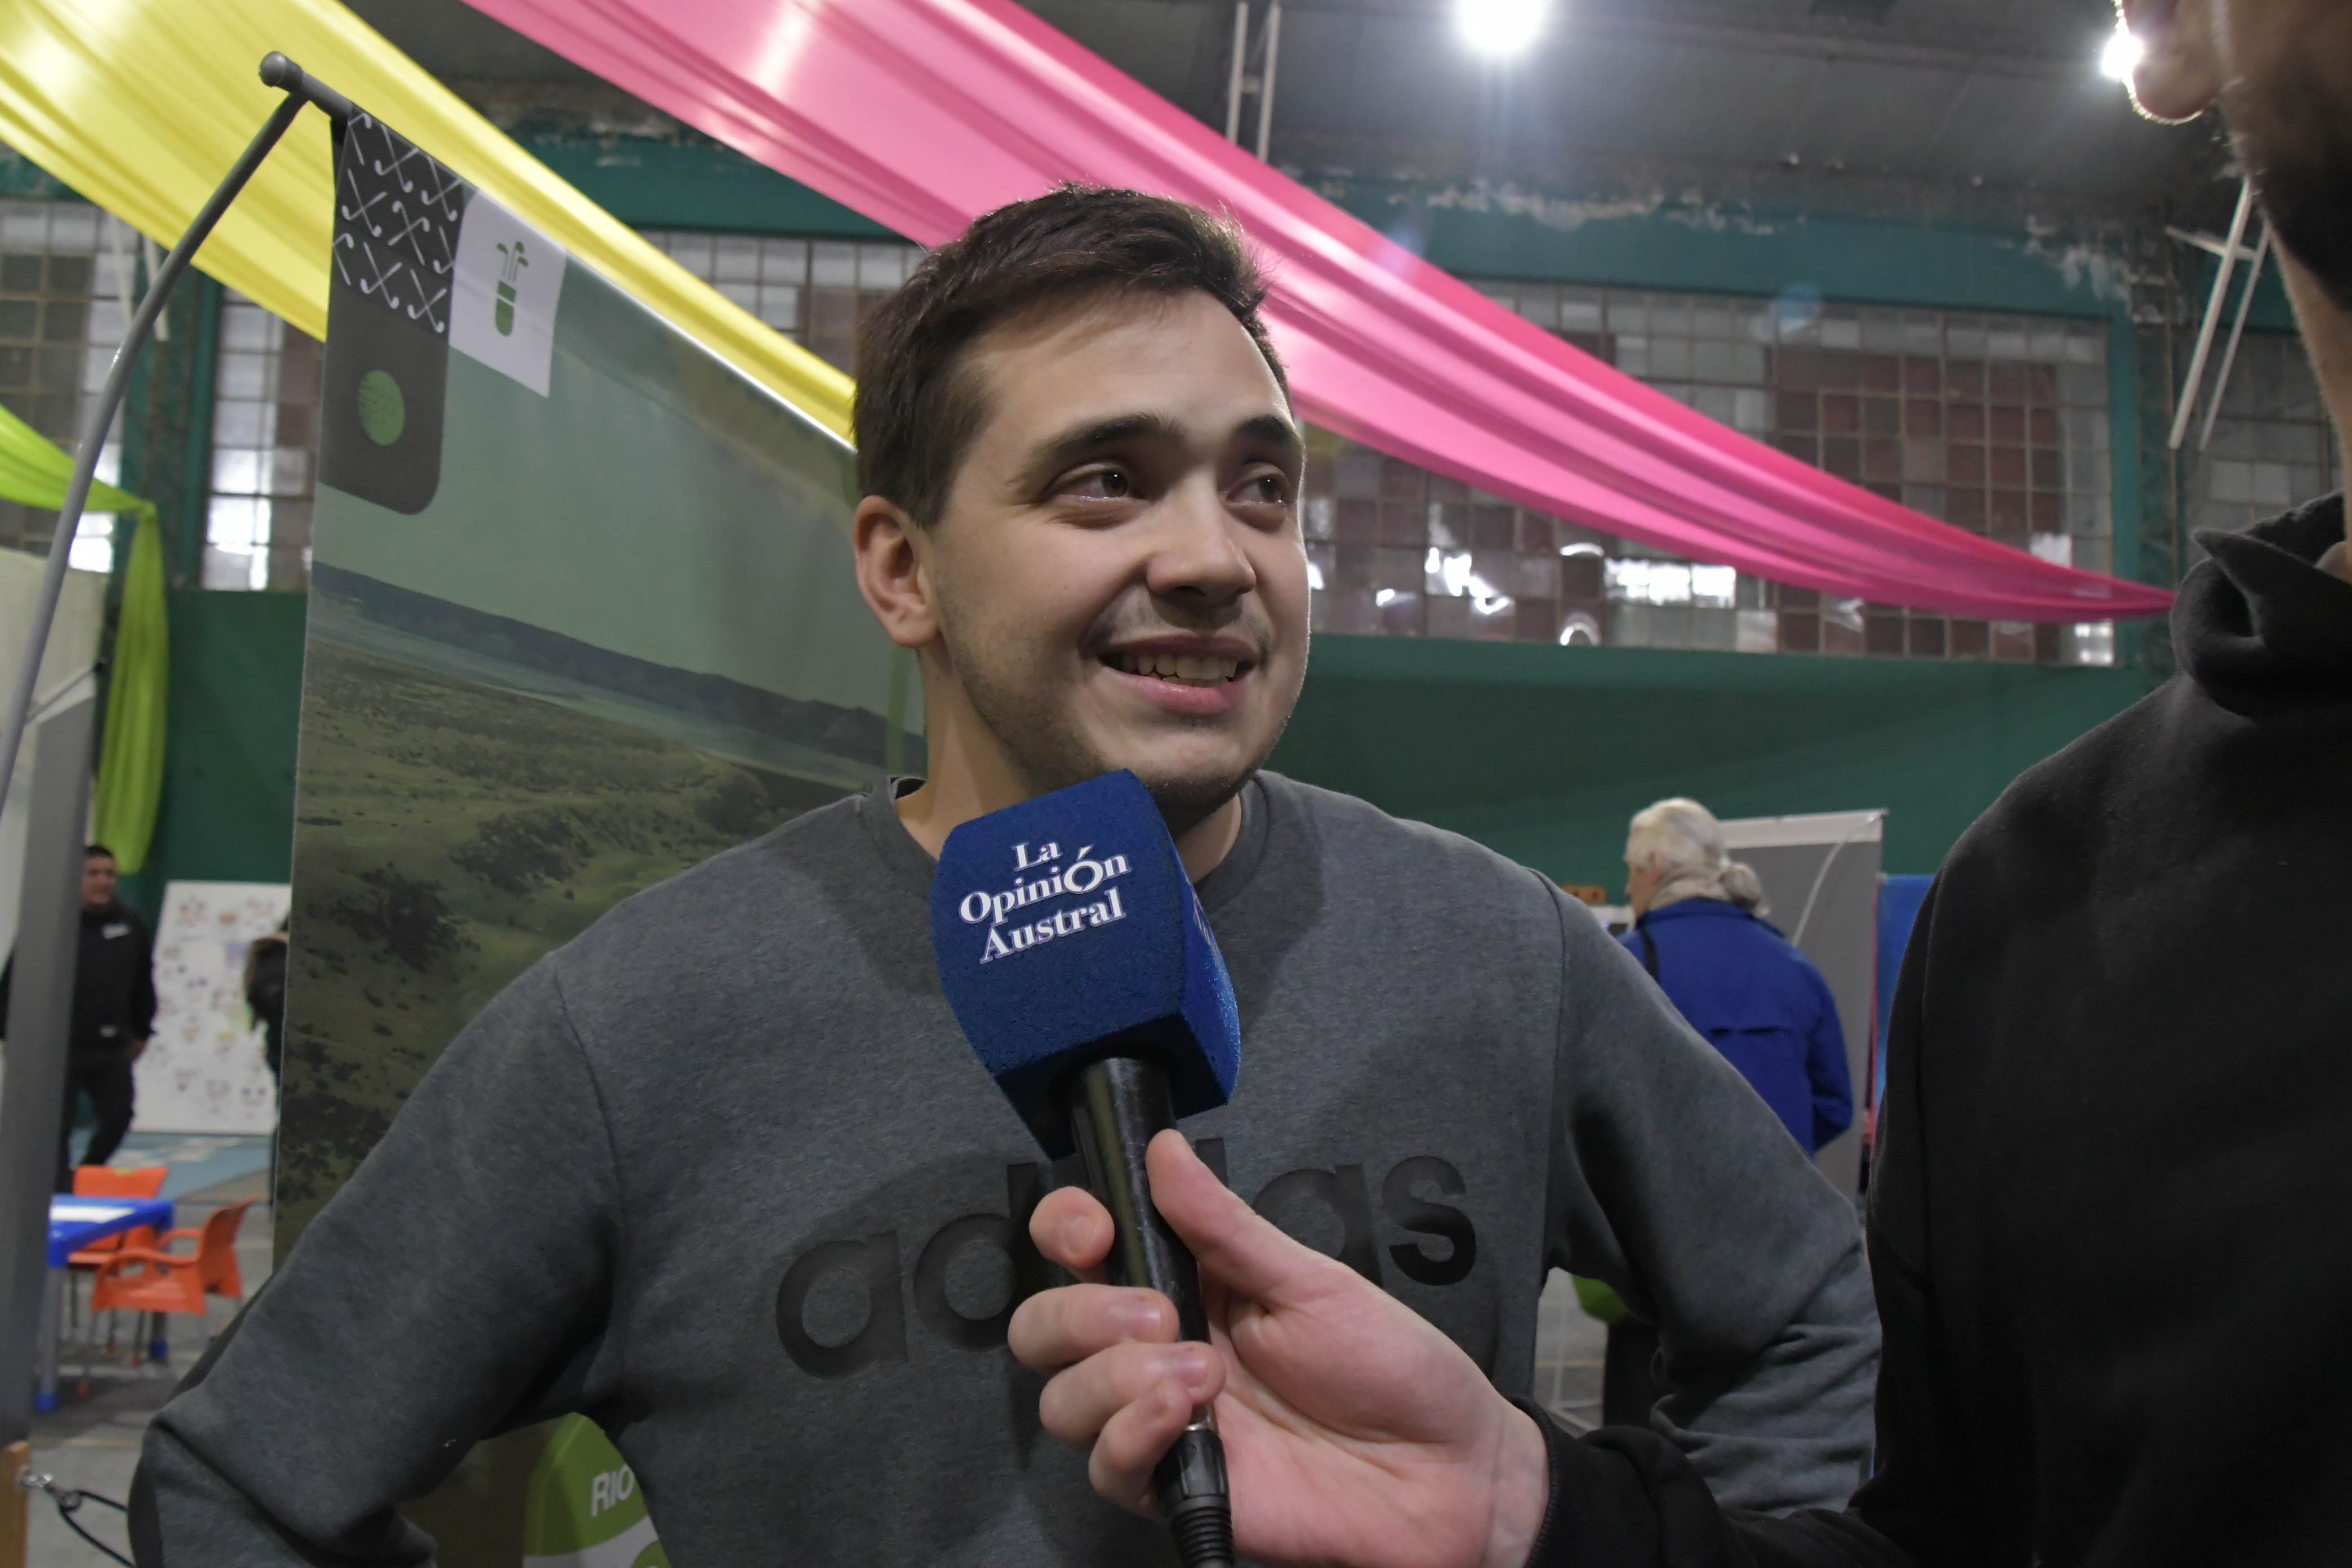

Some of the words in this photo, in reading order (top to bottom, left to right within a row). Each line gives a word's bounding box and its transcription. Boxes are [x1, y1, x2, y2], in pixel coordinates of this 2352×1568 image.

[1013, 841, 1061, 871] La
[980, 887, 1126, 964] Austral
[776, 1138, 1477, 1380] adas
[590, 1463, 635, 1518] RIO
